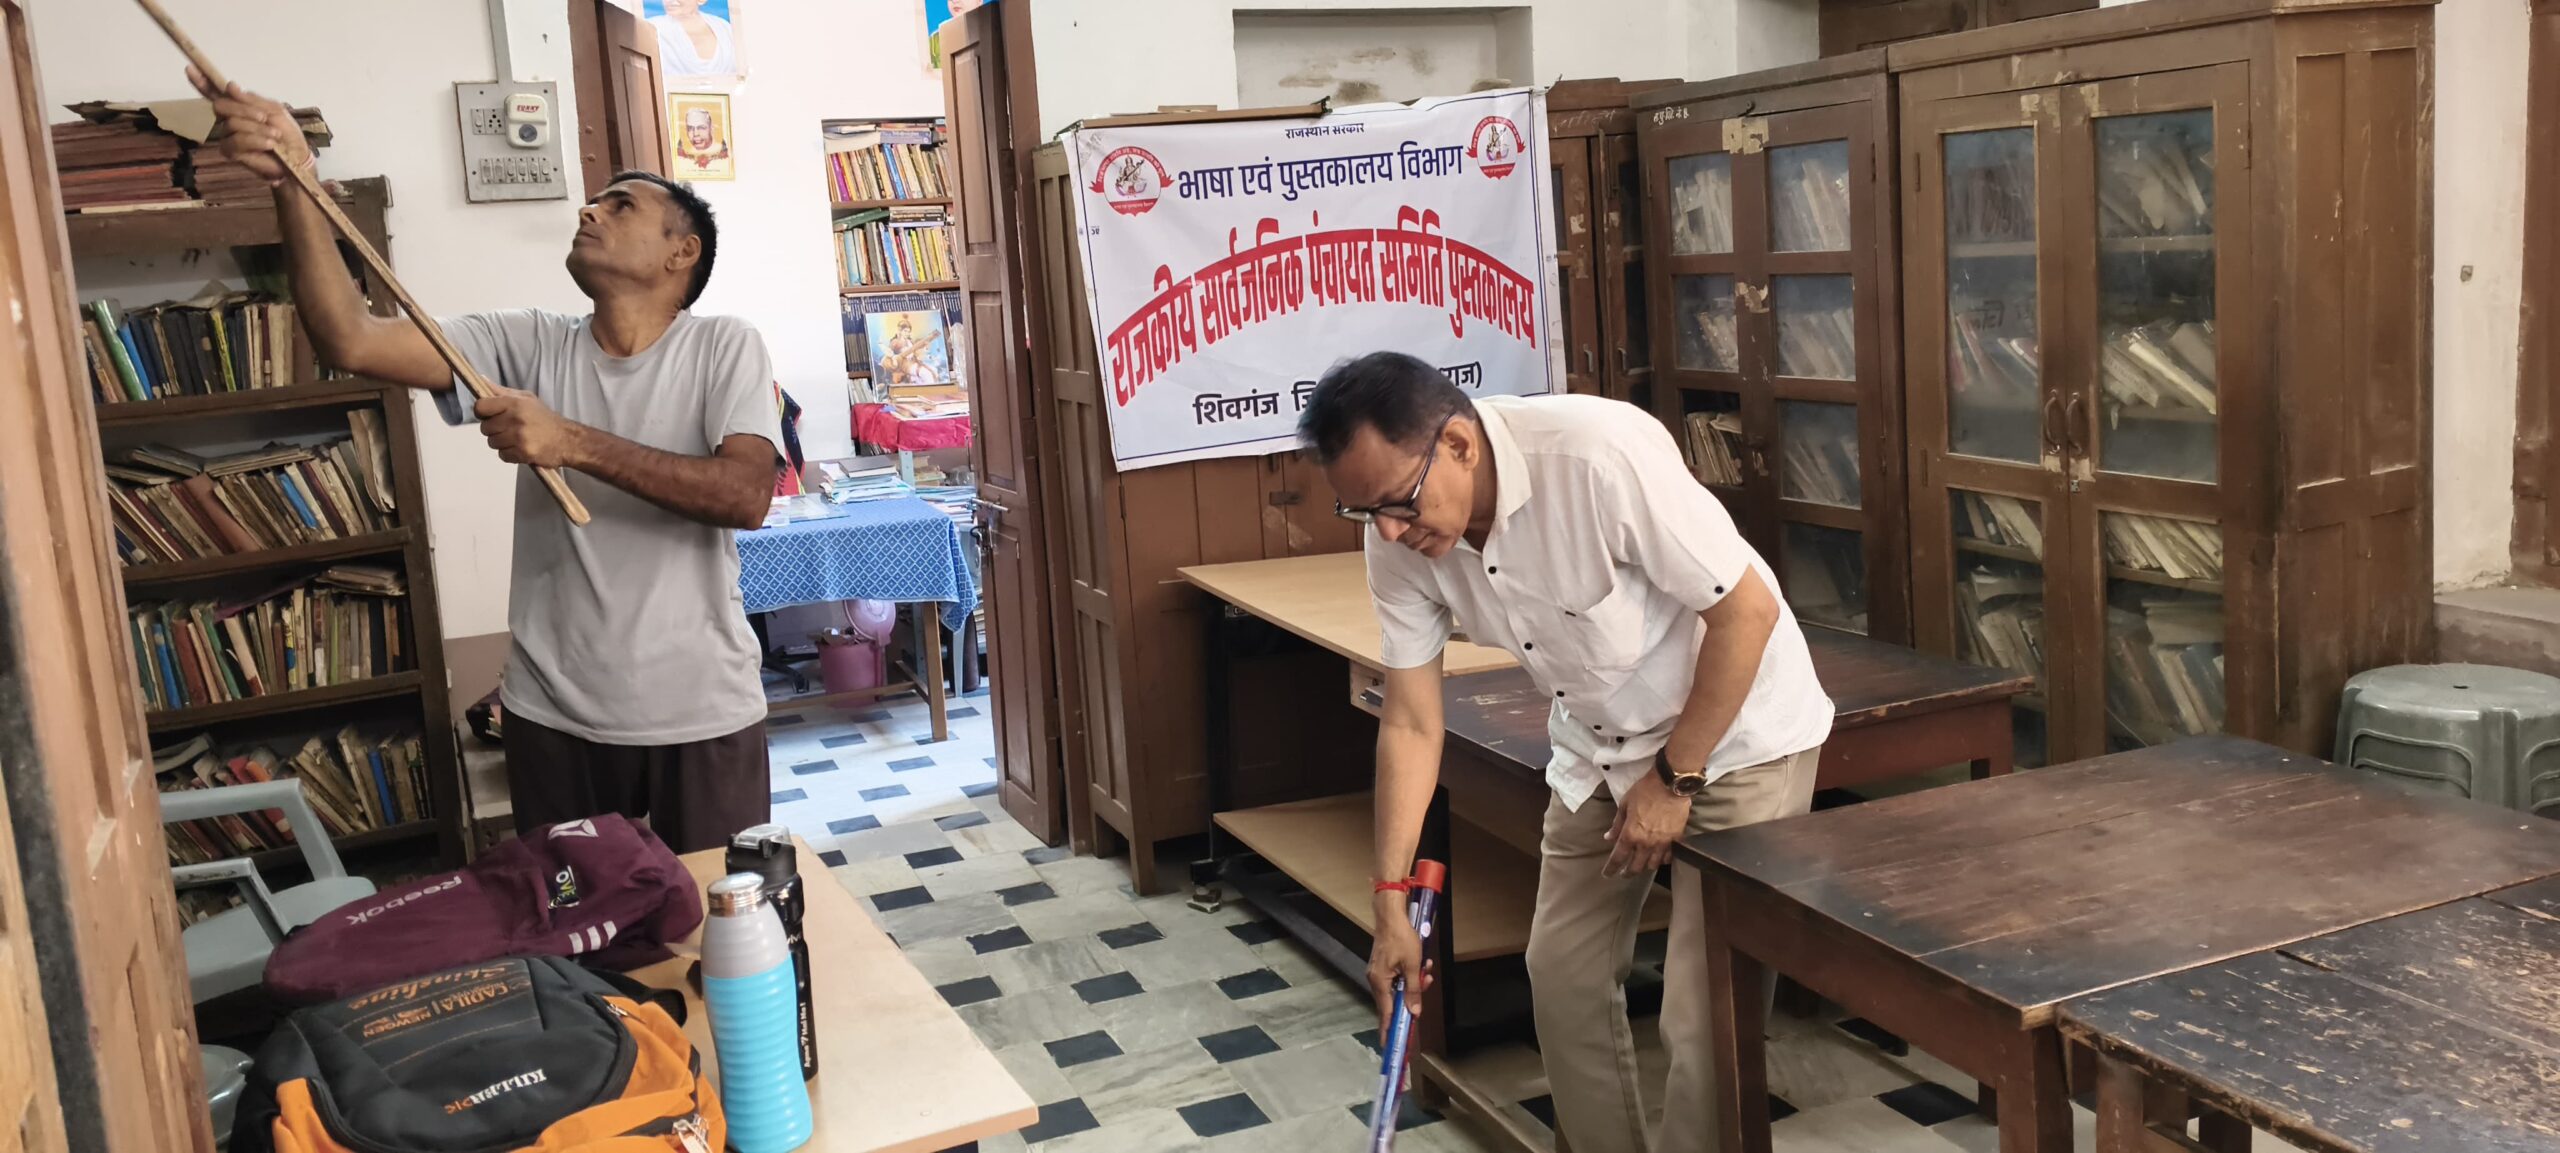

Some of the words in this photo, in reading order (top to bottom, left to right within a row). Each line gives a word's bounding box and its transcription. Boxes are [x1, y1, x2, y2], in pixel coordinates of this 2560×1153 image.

[1285, 126, 1329, 139] राजस्थान
[1332, 123, 1365, 135] सरकार
[1178, 168, 1234, 201] भाषा
[1239, 156, 1273, 195] एवं
[1278, 152, 1393, 201] पुस्तकालय
[1398, 140, 1464, 181] विभाग
[1107, 263, 1198, 407] राजकीय
[1195, 218, 1304, 345] सार्वजनिक
[1305, 211, 1376, 308] पंचायत
[1376, 205, 1444, 308] समिति
[1447, 238, 1536, 349] पुस्तकालय
[1192, 388, 1280, 425] शिवगंज
[1291, 380, 1317, 412] जि
[345, 875, 463, 926] Reebok
[441, 984, 509, 1012] CADILA
[363, 1010, 432, 1038] NEWGEN
